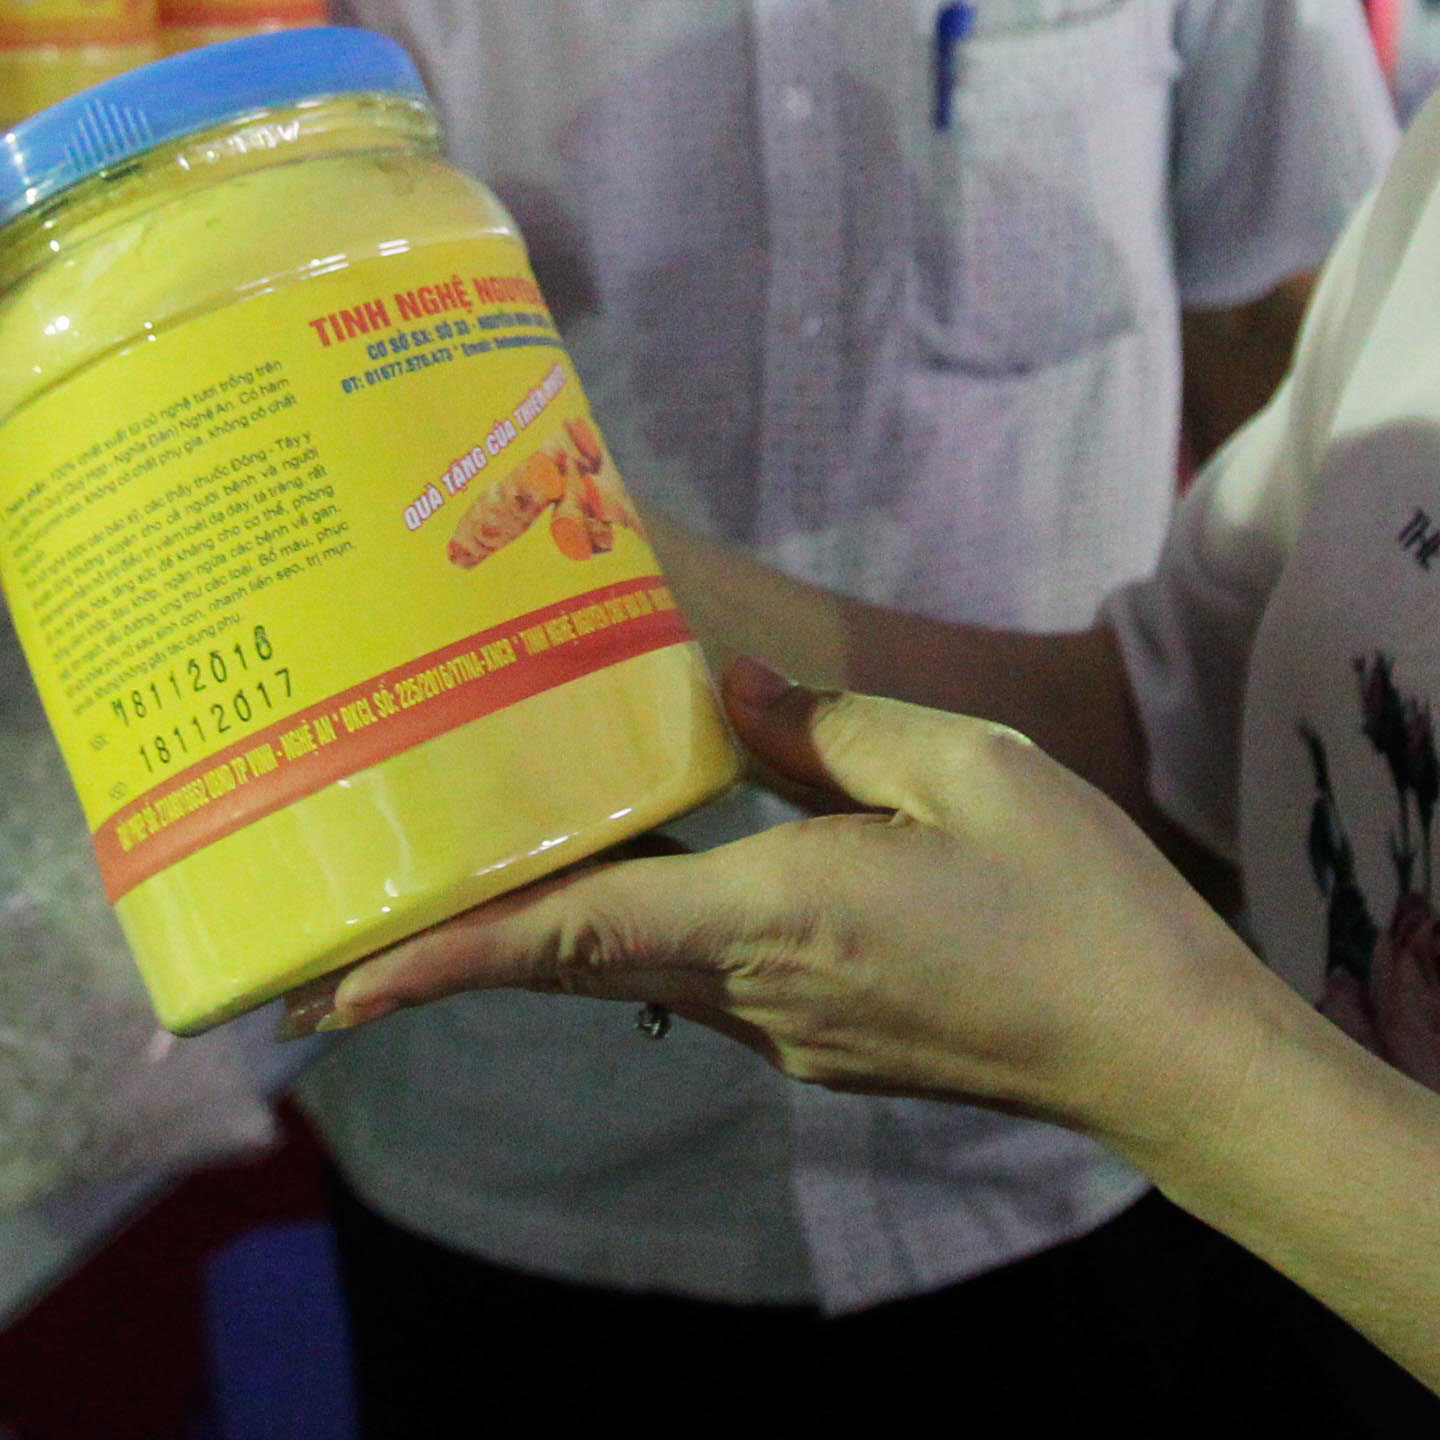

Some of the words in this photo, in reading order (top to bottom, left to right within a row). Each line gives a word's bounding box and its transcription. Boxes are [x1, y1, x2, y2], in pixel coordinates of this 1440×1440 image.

[309, 299, 391, 347] TINH
[394, 274, 473, 321] NGHỆ
[239, 389, 258, 403] Có
[249, 406, 266, 420] có
[275, 434, 300, 450] Tây
[223, 475, 257, 495] bệnh
[281, 448, 319, 471] người
[403, 482, 444, 531] QUÀ
[440, 445, 487, 496] TẶNG
[485, 419, 517, 456] CỦA
[216, 524, 240, 541] cho
[292, 485, 334, 509] phòng
[315, 520, 349, 541] phục
[229, 540, 253, 556] các
[255, 524, 289, 545] bệnh
[207, 587, 248, 611] nhanh
[305, 552, 321, 566] trị
[139, 668, 291, 772] 18112017
